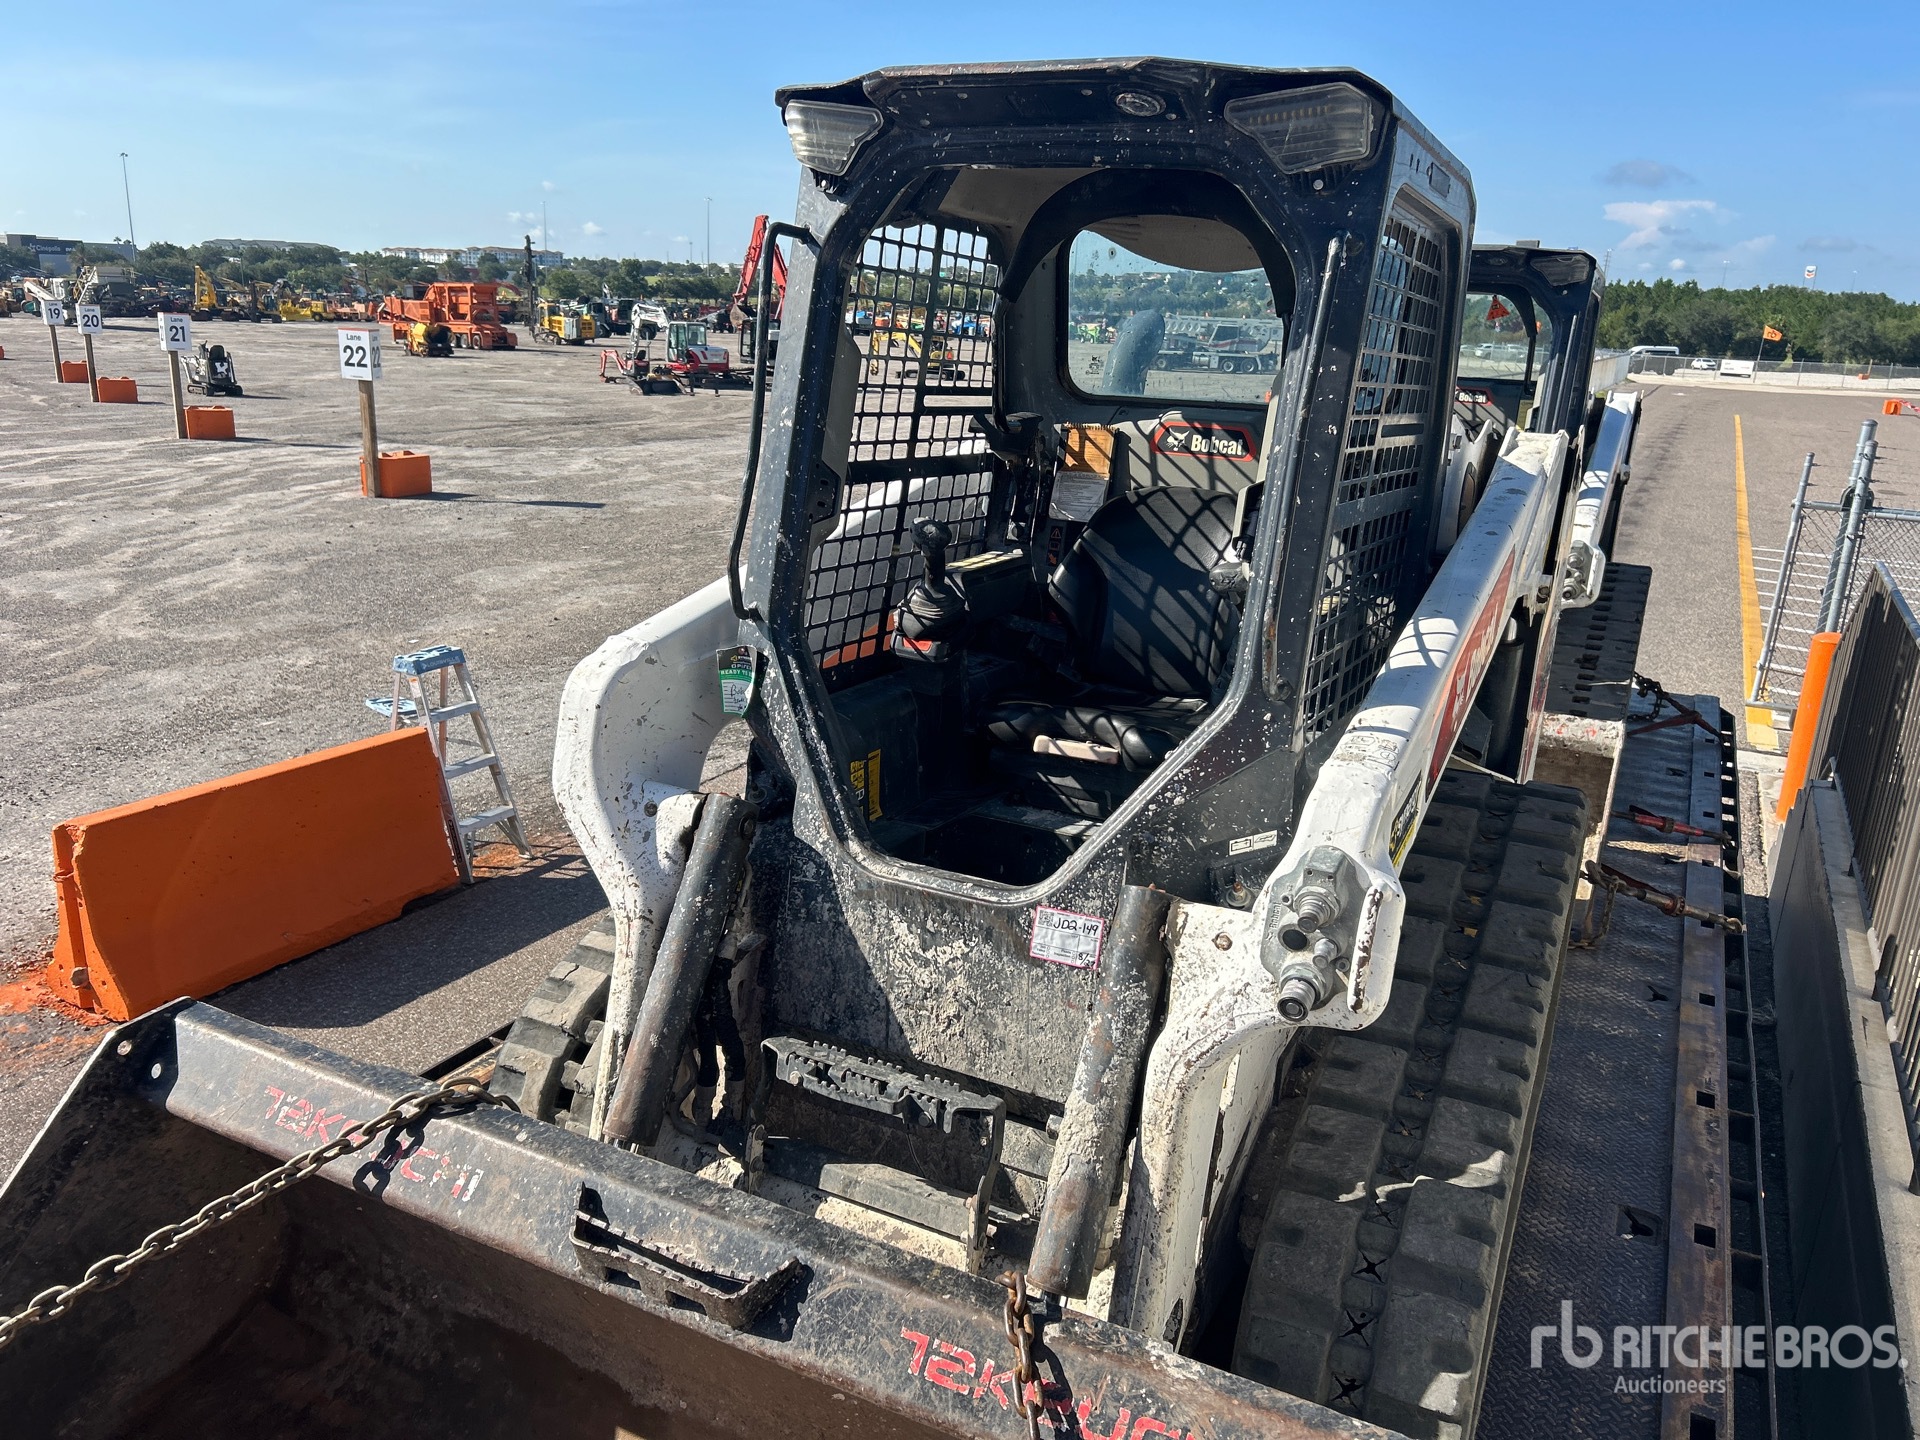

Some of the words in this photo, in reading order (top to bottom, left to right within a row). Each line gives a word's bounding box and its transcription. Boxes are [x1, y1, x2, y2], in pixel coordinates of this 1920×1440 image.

[48, 308, 60, 319] 19
[82, 315, 100, 327] 20
[169, 325, 186, 342] 21
[346, 333, 362, 341] Lane
[343, 344, 368, 368] 22
[1190, 434, 1244, 456] Bobcat
